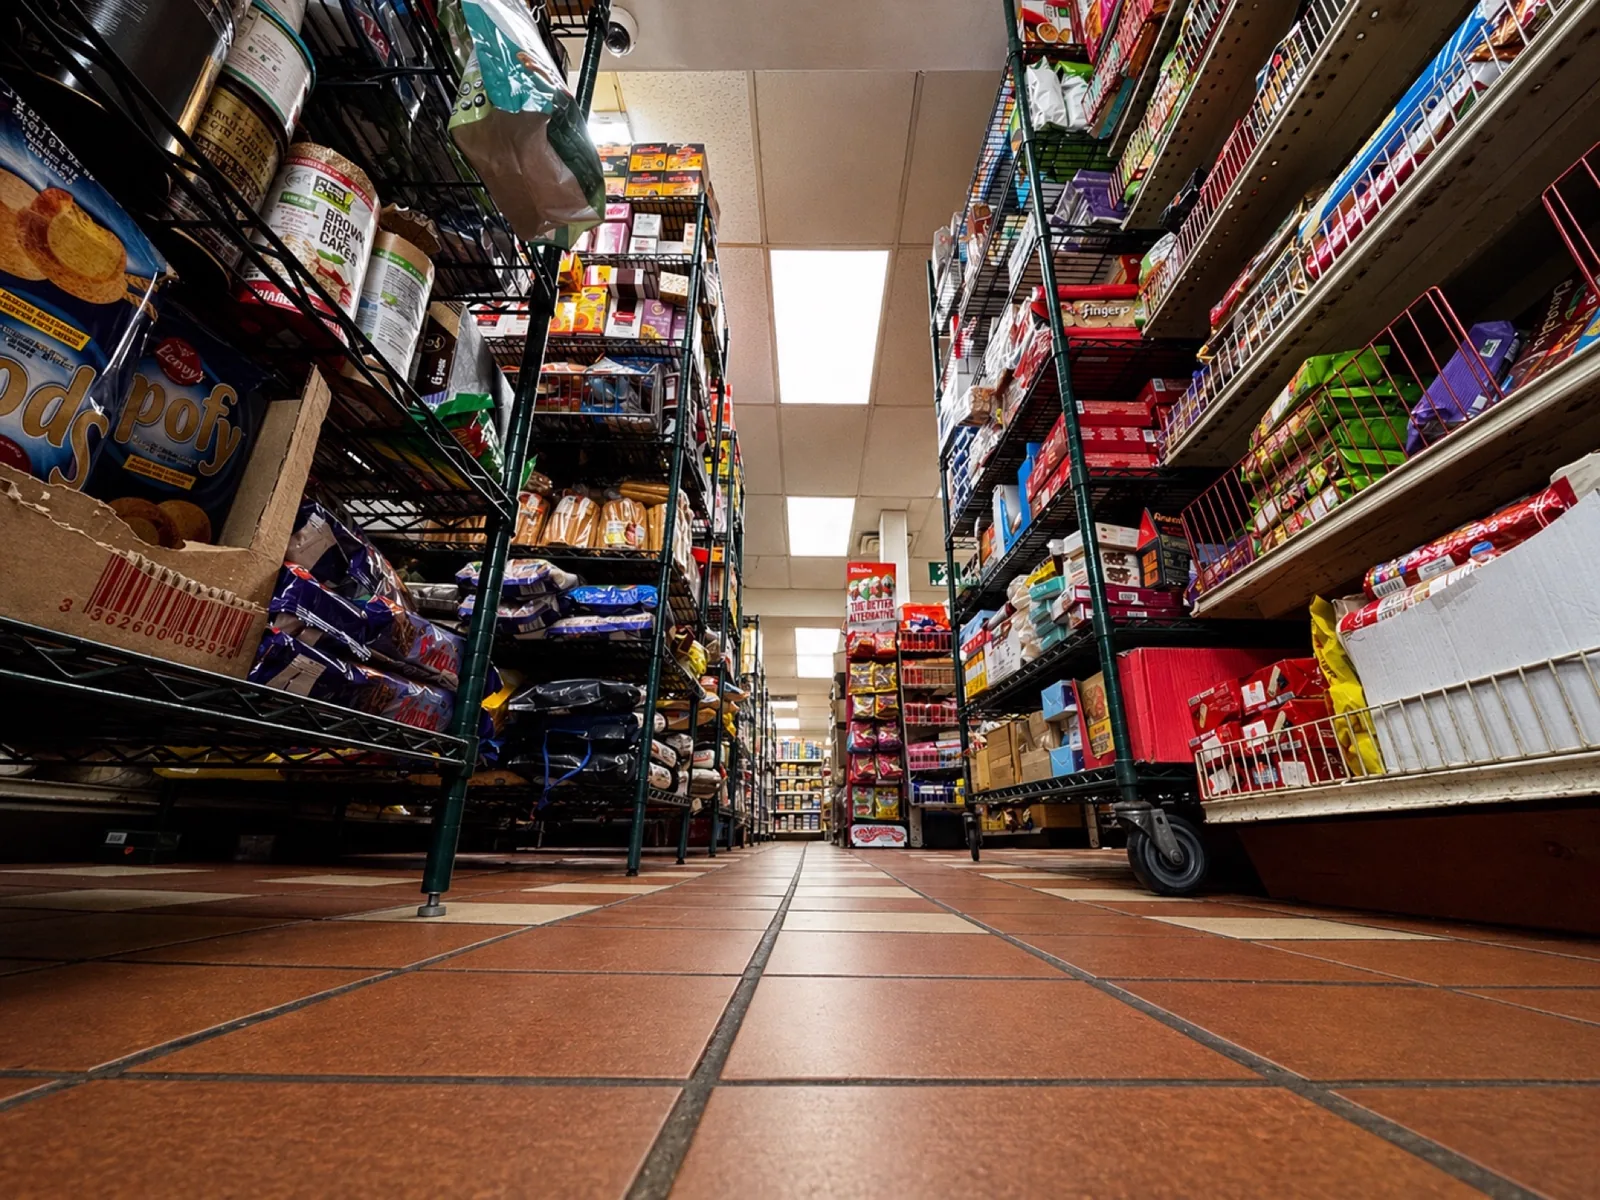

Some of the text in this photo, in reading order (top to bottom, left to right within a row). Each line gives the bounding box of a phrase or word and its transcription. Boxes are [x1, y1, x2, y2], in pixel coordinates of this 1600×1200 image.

[323, 220, 350, 247] RICE
[325, 208, 365, 243] BROWN
[319, 231, 357, 267] CAKES
[59, 598, 73, 612] 3
